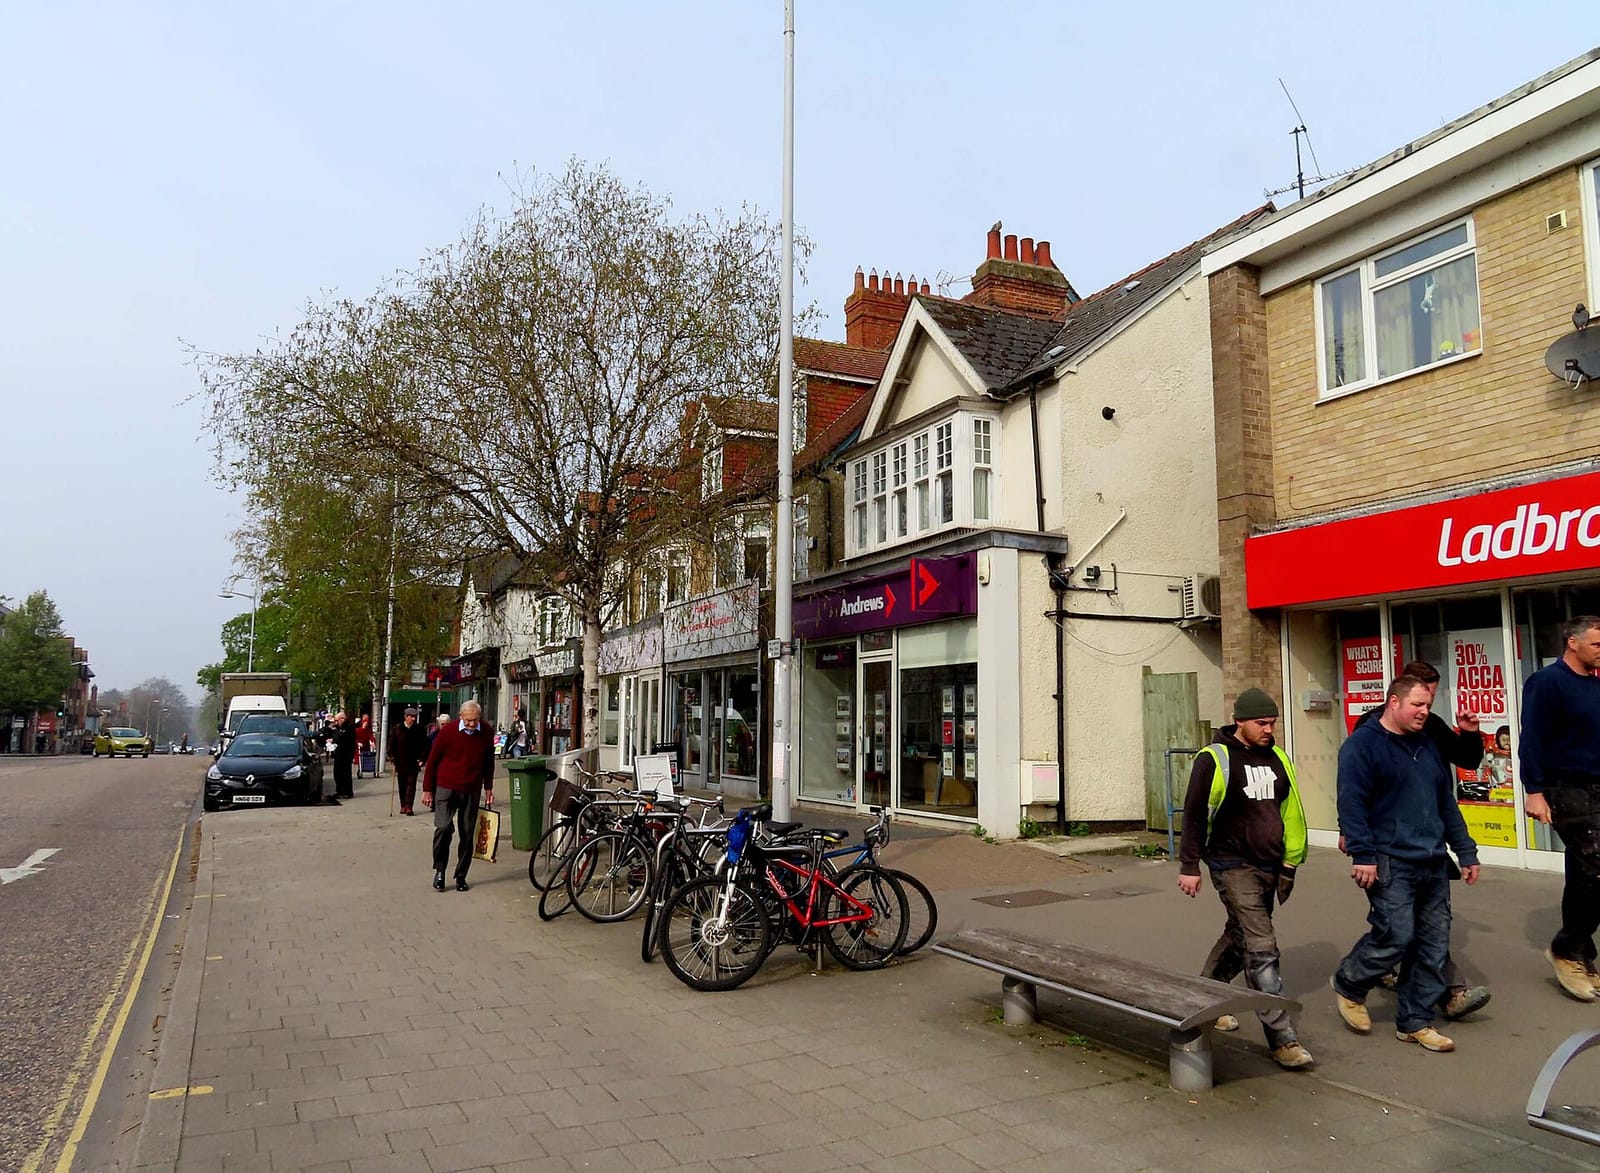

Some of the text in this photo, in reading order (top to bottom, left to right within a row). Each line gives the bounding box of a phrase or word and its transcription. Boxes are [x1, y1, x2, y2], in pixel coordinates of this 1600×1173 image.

[840, 595, 884, 617] Andrews
[1346, 645, 1379, 660] WHAT'S
[1455, 643, 1488, 666] 30%
[1457, 665, 1504, 690] ACCA
